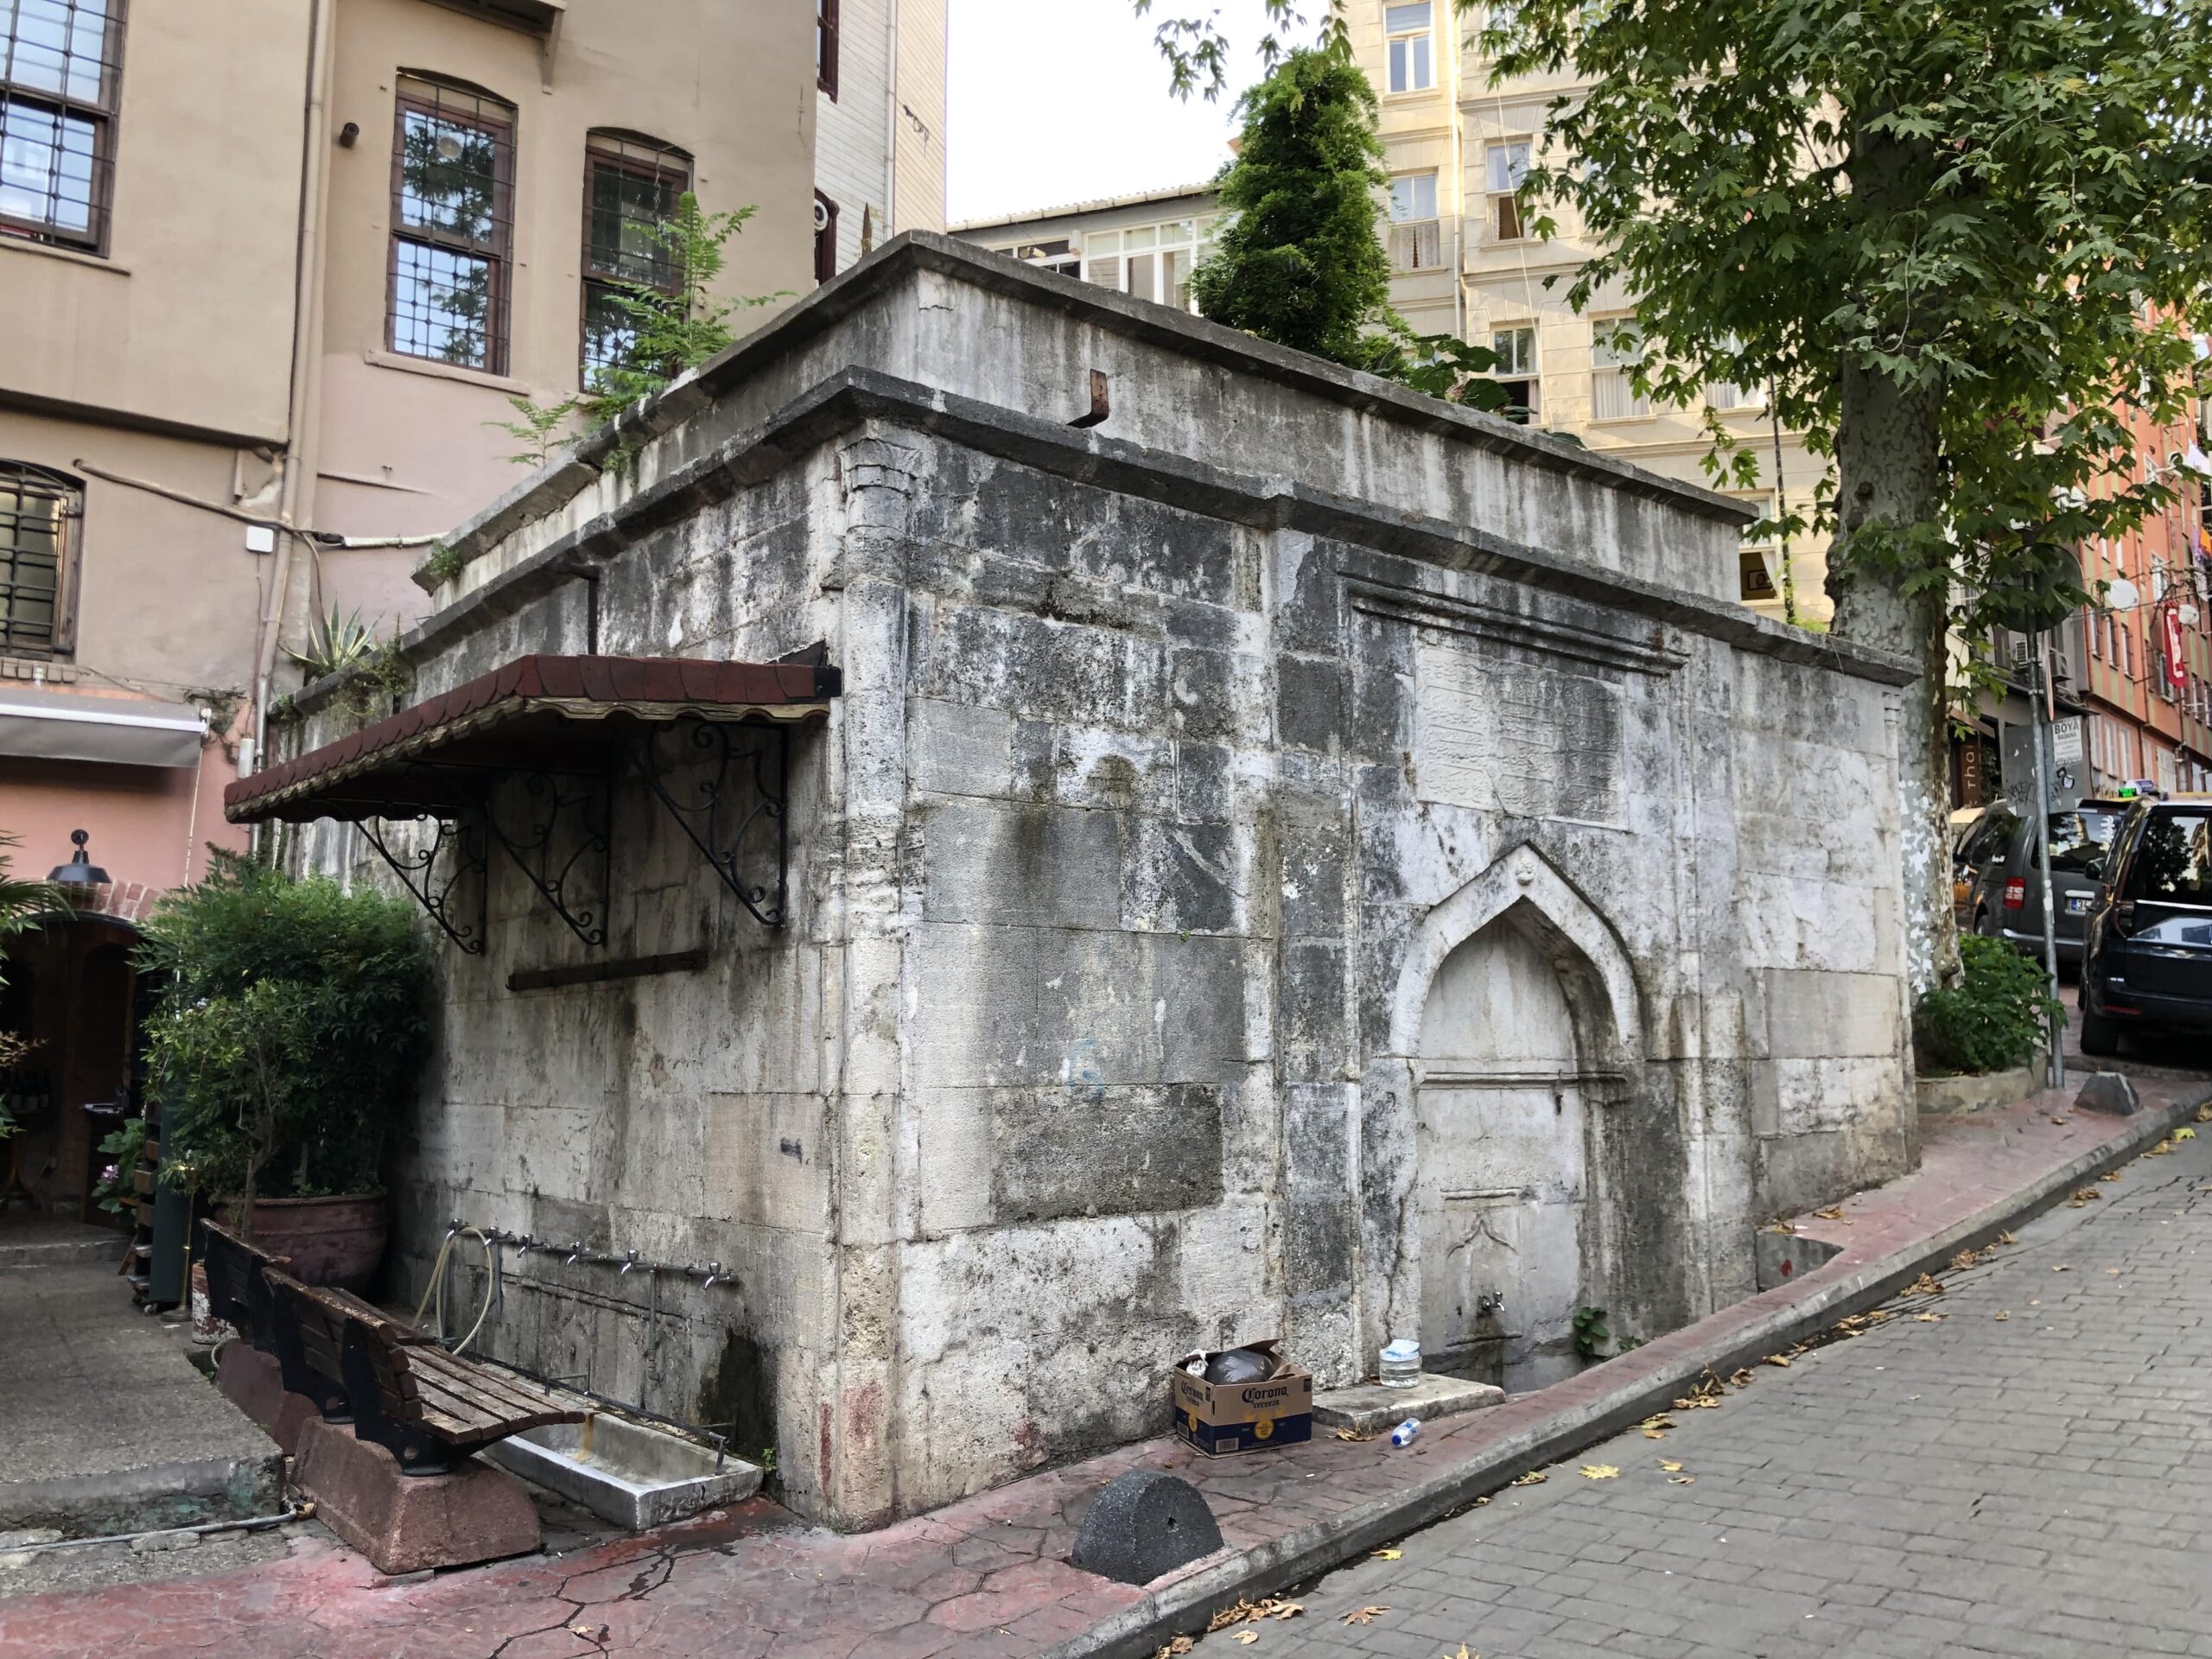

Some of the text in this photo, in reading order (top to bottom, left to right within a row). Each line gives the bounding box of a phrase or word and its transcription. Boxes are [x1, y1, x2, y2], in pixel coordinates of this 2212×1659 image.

[2055, 719, 2079, 734] BOYA
[1181, 1381, 1204, 1402] Corona
[1242, 1386, 1288, 1403] Corona
